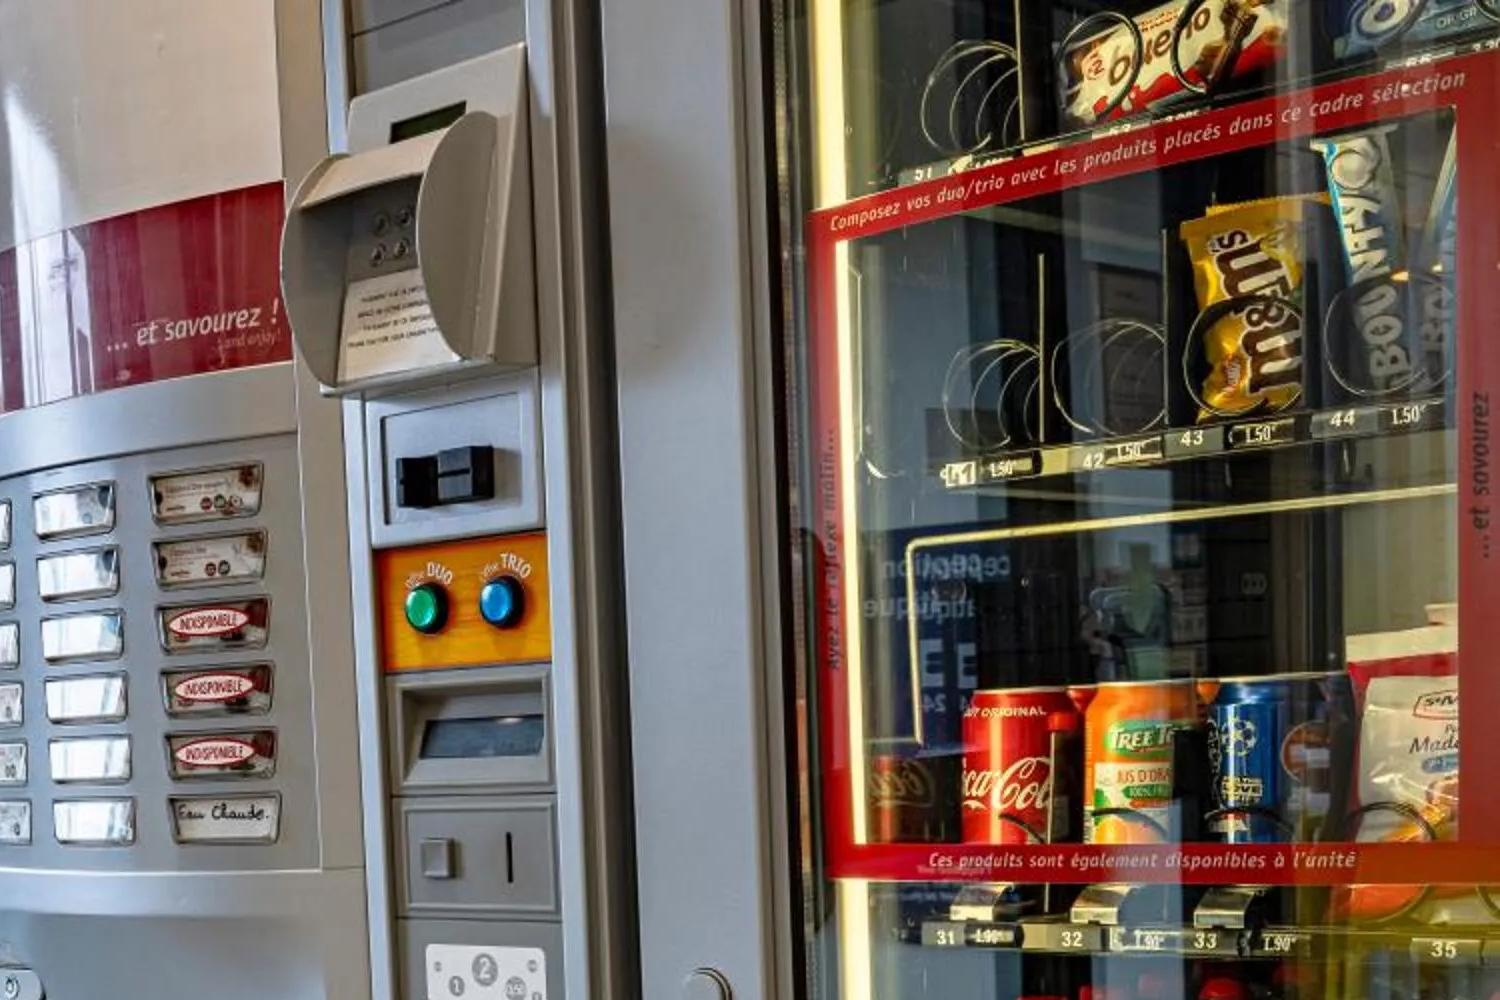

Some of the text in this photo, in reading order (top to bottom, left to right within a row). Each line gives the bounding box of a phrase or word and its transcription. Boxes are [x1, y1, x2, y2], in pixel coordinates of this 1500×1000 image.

[830, 202, 901, 231] Composez
[907, 194, 930, 211] vos
[937, 173, 1004, 204] duo/trio
[1011, 162, 1048, 183] avec
[1054, 158, 1077, 176] les
[1084, 136, 1157, 173] produits
[1164, 124, 1221, 155] placés
[1229, 112, 1273, 135] dans
[1281, 106, 1301, 123] ce
[1309, 92, 1364, 117] cadre
[1372, 71, 1466, 103] sélection
[136, 322, 156, 347] et
[165, 307, 262, 341] savourez
[1330, 409, 1357, 428] 44
[1180, 430, 1204, 448] 43
[1473, 390, 1491, 496] savourez
[1083, 451, 1105, 469] 42
[1469, 505, 1491, 530] et
[426, 562, 453, 585] DUO
[500, 553, 532, 579] TRIO
[183, 679, 243, 696] INDISPONIBLE
[981, 705, 1048, 717] ORIGINAL
[1112, 727, 1153, 750] TREE
[929, 851, 1356, 871] Ces produits sont également disponibles à l'unité
[936, 930, 955, 945] 31
[1061, 931, 1083, 948] 32
[1194, 932, 1217, 949] 33
[1430, 940, 1457, 960] 35
[479, 957, 491, 980] 2
